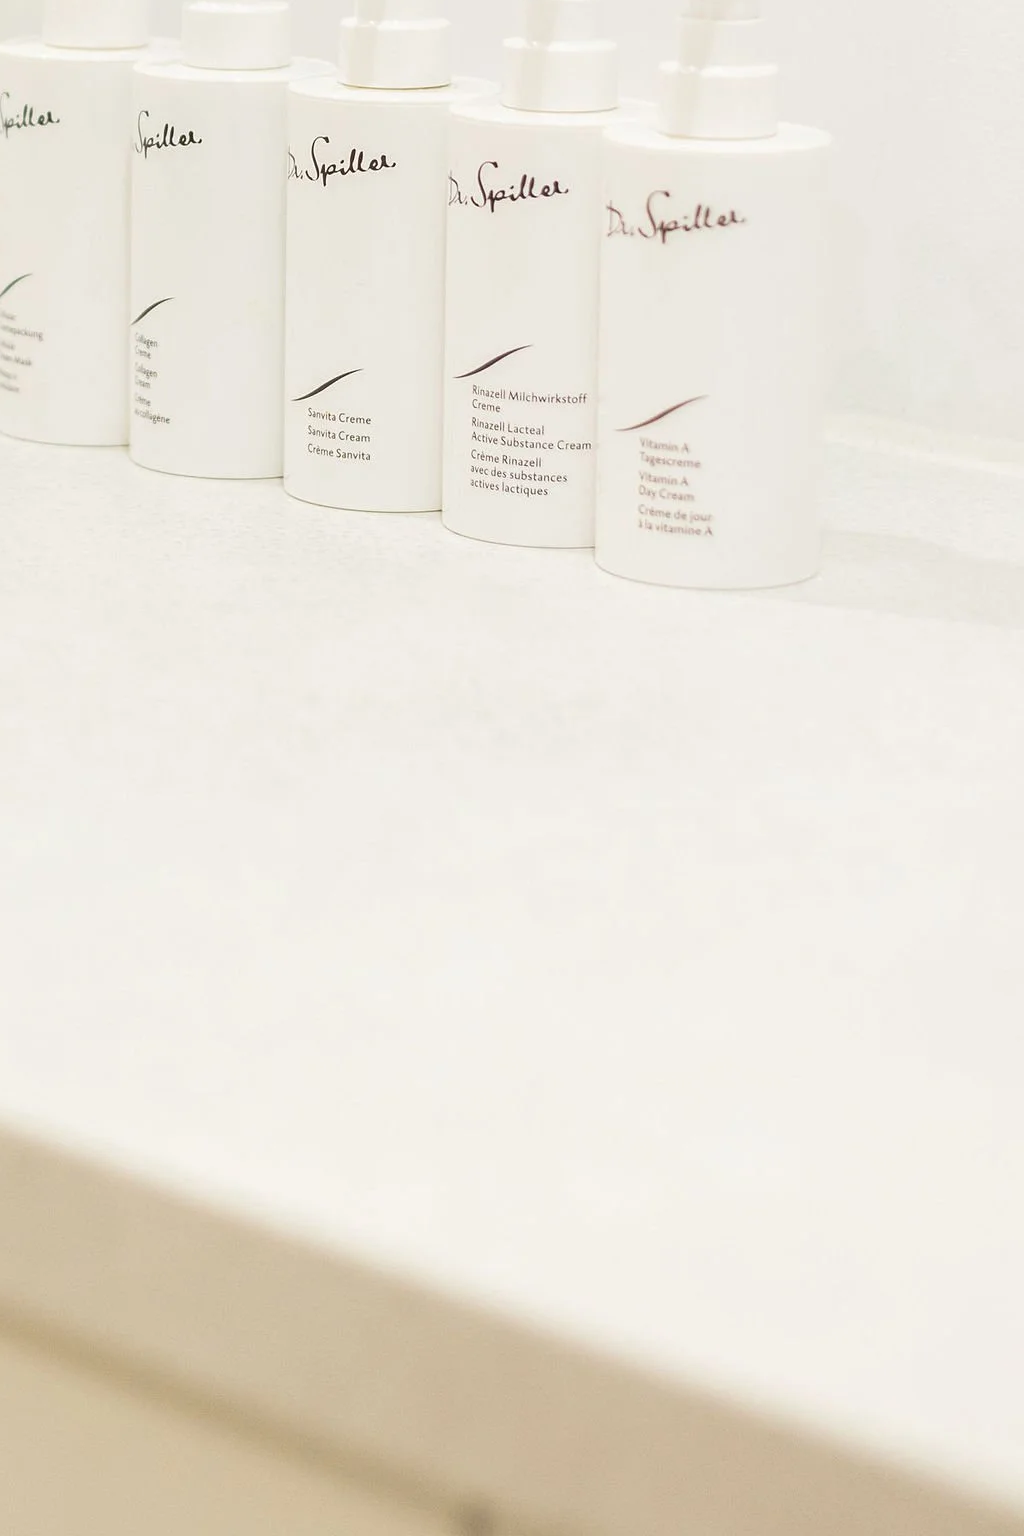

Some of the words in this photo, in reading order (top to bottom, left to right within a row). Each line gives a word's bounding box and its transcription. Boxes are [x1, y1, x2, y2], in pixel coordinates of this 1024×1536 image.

[134, 110, 203, 159] Spiller
[305, 135, 397, 187] Spiller
[470, 161, 569, 213] Spiller
[638, 190, 746, 244] Spiller
[472, 384, 506, 400] Rinazell
[508, 391, 588, 404] Milchwirkstoff
[472, 398, 501, 413] Creme
[308, 407, 336, 422] Sanvita
[338, 412, 372, 425] Creme
[308, 425, 336, 440] Sanvita
[338, 430, 371, 443] Cream
[471, 416, 505, 432] Rinazell
[507, 423, 545, 436] Lacteal
[471, 431, 498, 445] Active
[500, 436, 554, 450] Substance
[556, 440, 592, 451] Cream
[639, 437, 678, 451] Vitamin
[681, 442, 690, 453] A
[307, 443, 334, 457] Crème
[336, 448, 371, 461] Sanvita
[470, 449, 500, 464] Crème
[502, 454, 542, 468] Rinazell
[639, 451, 701, 468] Tagescreme
[470, 465, 489, 476] avec
[490, 467, 507, 479] des
[509, 471, 568, 483] substances
[638, 470, 678, 485] Vitamin
[680, 476, 689, 486] A
[470, 479, 500, 492] actives
[501, 482, 549, 498] lactiques
[638, 484, 656, 500] Day
[658, 488, 695, 501] Cream
[673, 510, 687, 520] de
[688, 512, 712, 523] jour
[655, 522, 702, 535] vitamine
[704, 527, 714, 536] A
